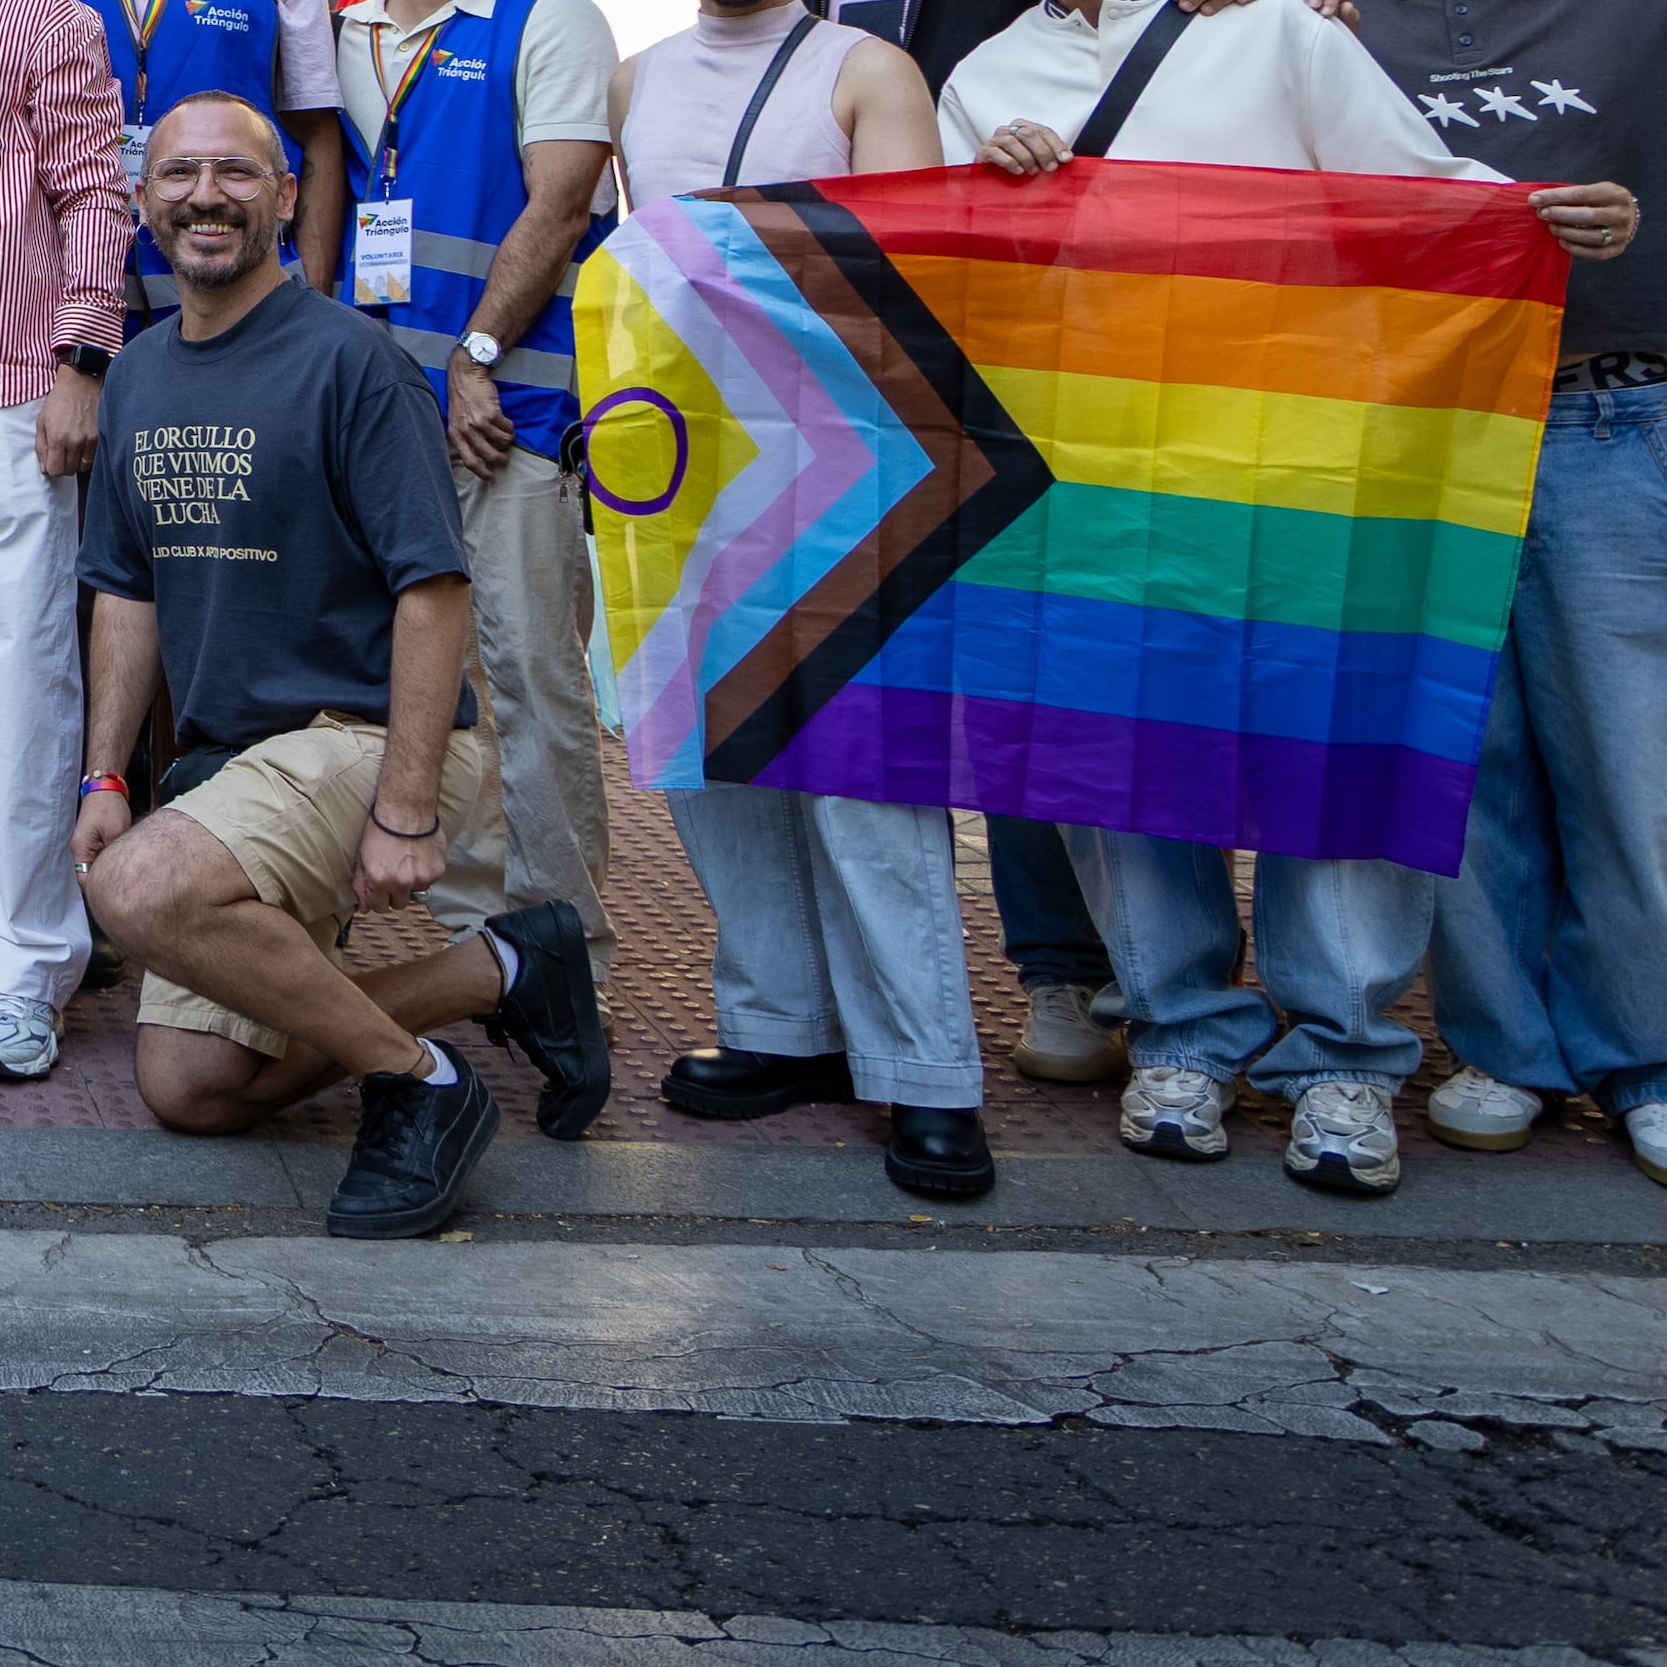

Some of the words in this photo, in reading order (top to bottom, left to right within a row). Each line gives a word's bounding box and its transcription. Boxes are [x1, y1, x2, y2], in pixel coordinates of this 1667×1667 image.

[194, 14, 250, 33] Triángulo
[207, 6, 249, 22] Acción
[365, 224, 410, 238] Triángulo
[375, 216, 408, 227] Acción
[134, 430, 153, 453] EL
[154, 426, 256, 451] ORGULLO
[133, 452, 166, 482] QUE
[167, 452, 253, 476] VIVIMOS
[196, 477, 215, 499] DE
[217, 478, 251, 501] LA
[154, 502, 221, 525] LUCHA
[171, 545, 197, 558] CLUB
[198, 547, 205, 557] X
[220, 547, 278, 562] POSITIVO
